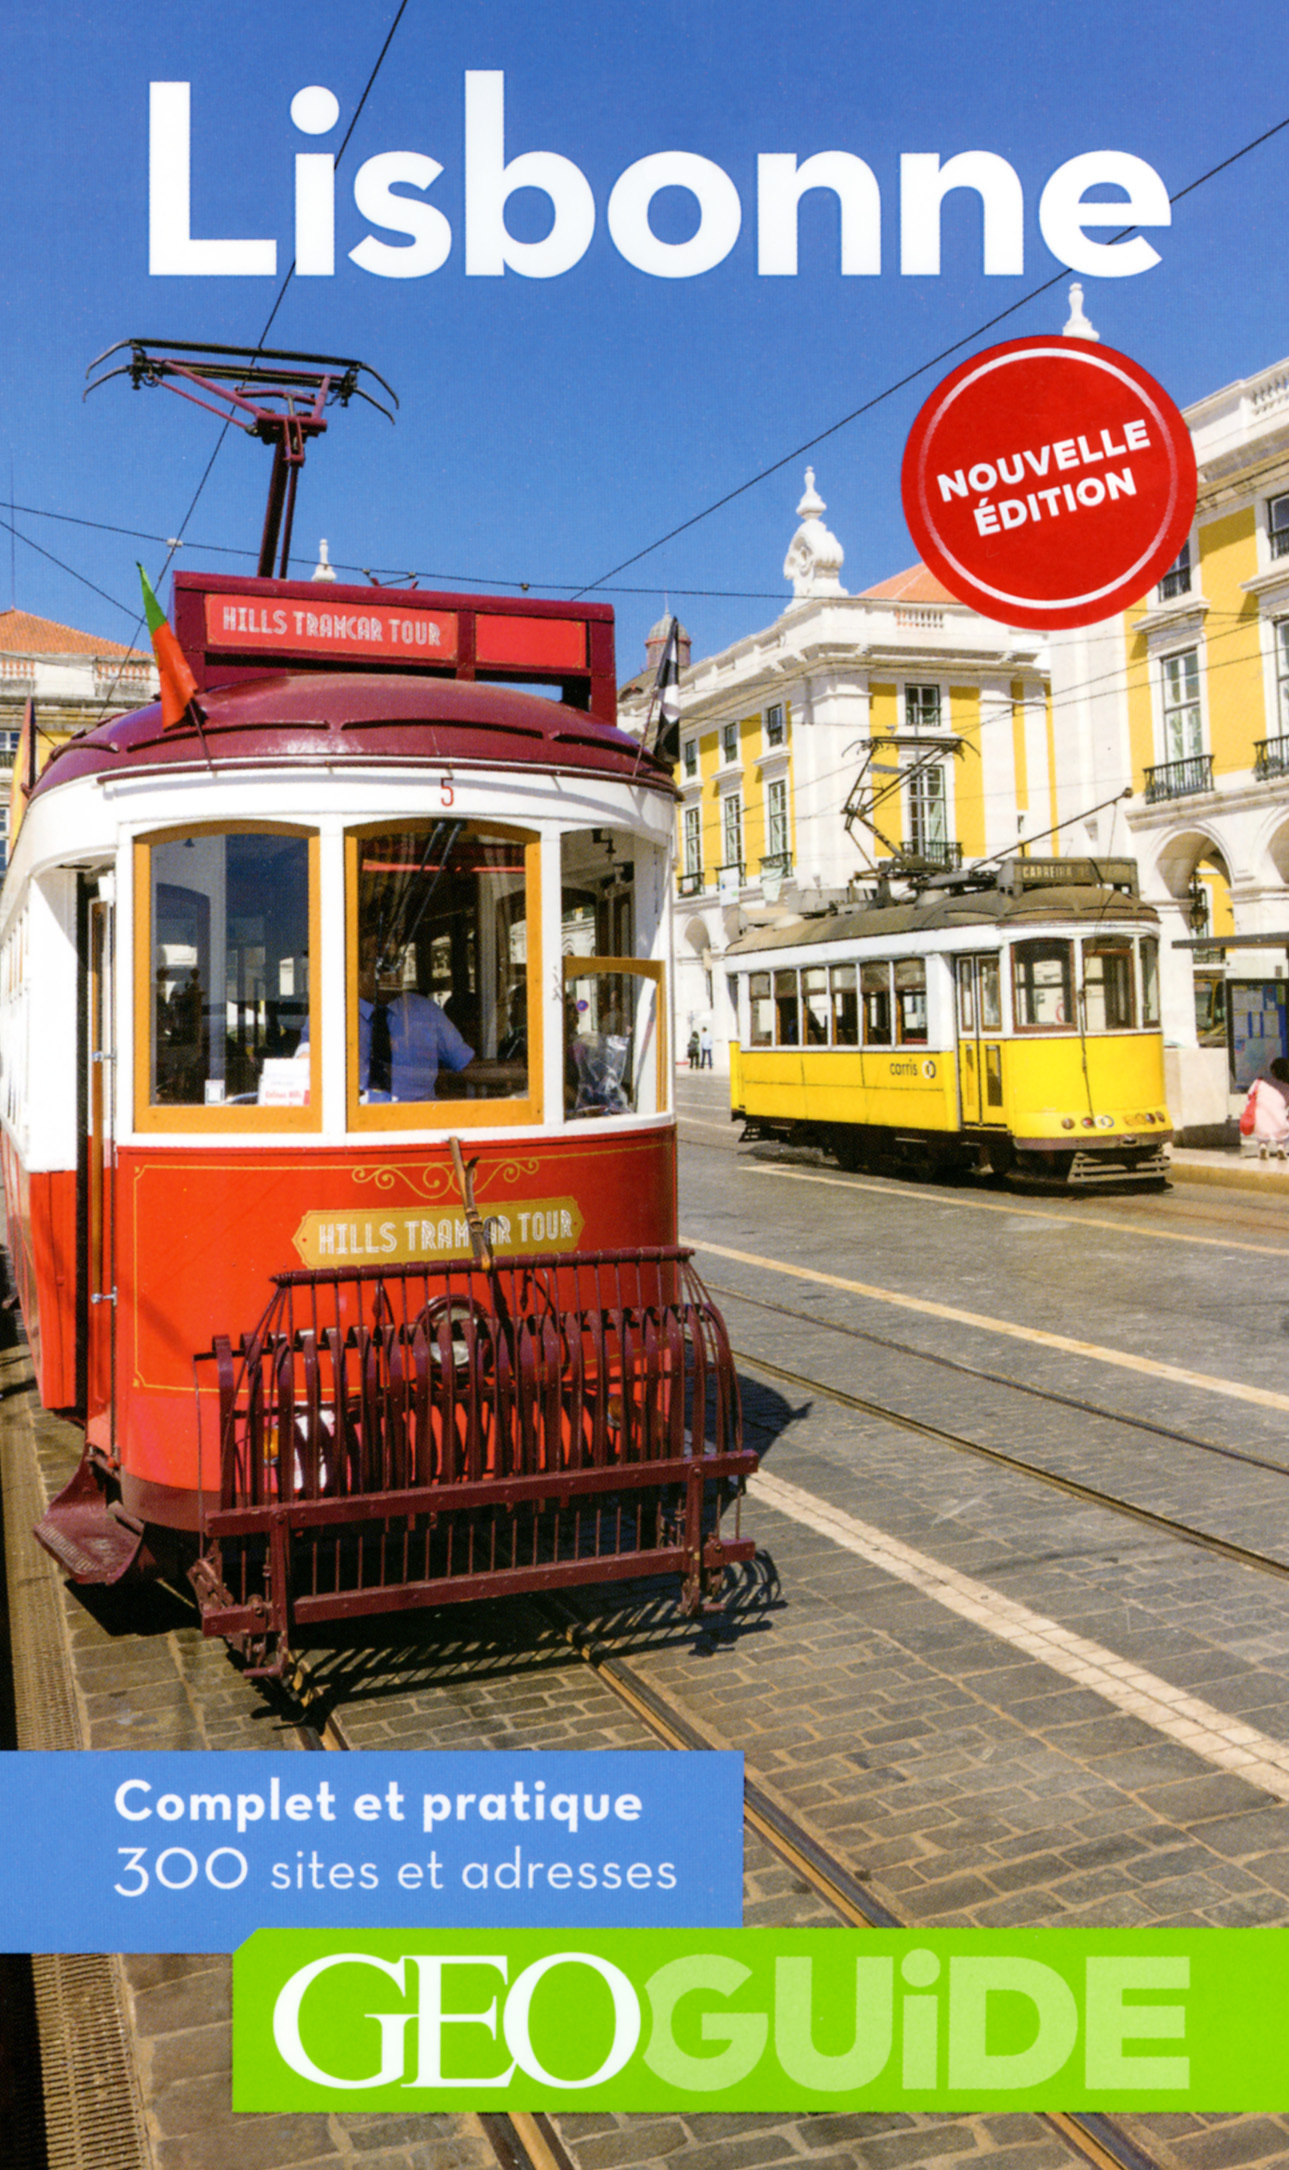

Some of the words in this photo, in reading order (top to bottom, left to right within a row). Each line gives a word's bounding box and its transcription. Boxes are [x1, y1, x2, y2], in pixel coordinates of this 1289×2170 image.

[222, 605, 287, 636] HILLS
[292, 610, 383, 643] TRAMCAR
[387, 618, 442, 647] TOUR
[440, 777, 454, 807] 5
[889, 1058, 918, 1076] carris
[317, 1220, 398, 1256] HILLS
[403, 1215, 513, 1251] TRAMAR
[517, 1209, 573, 1243] TOUR
